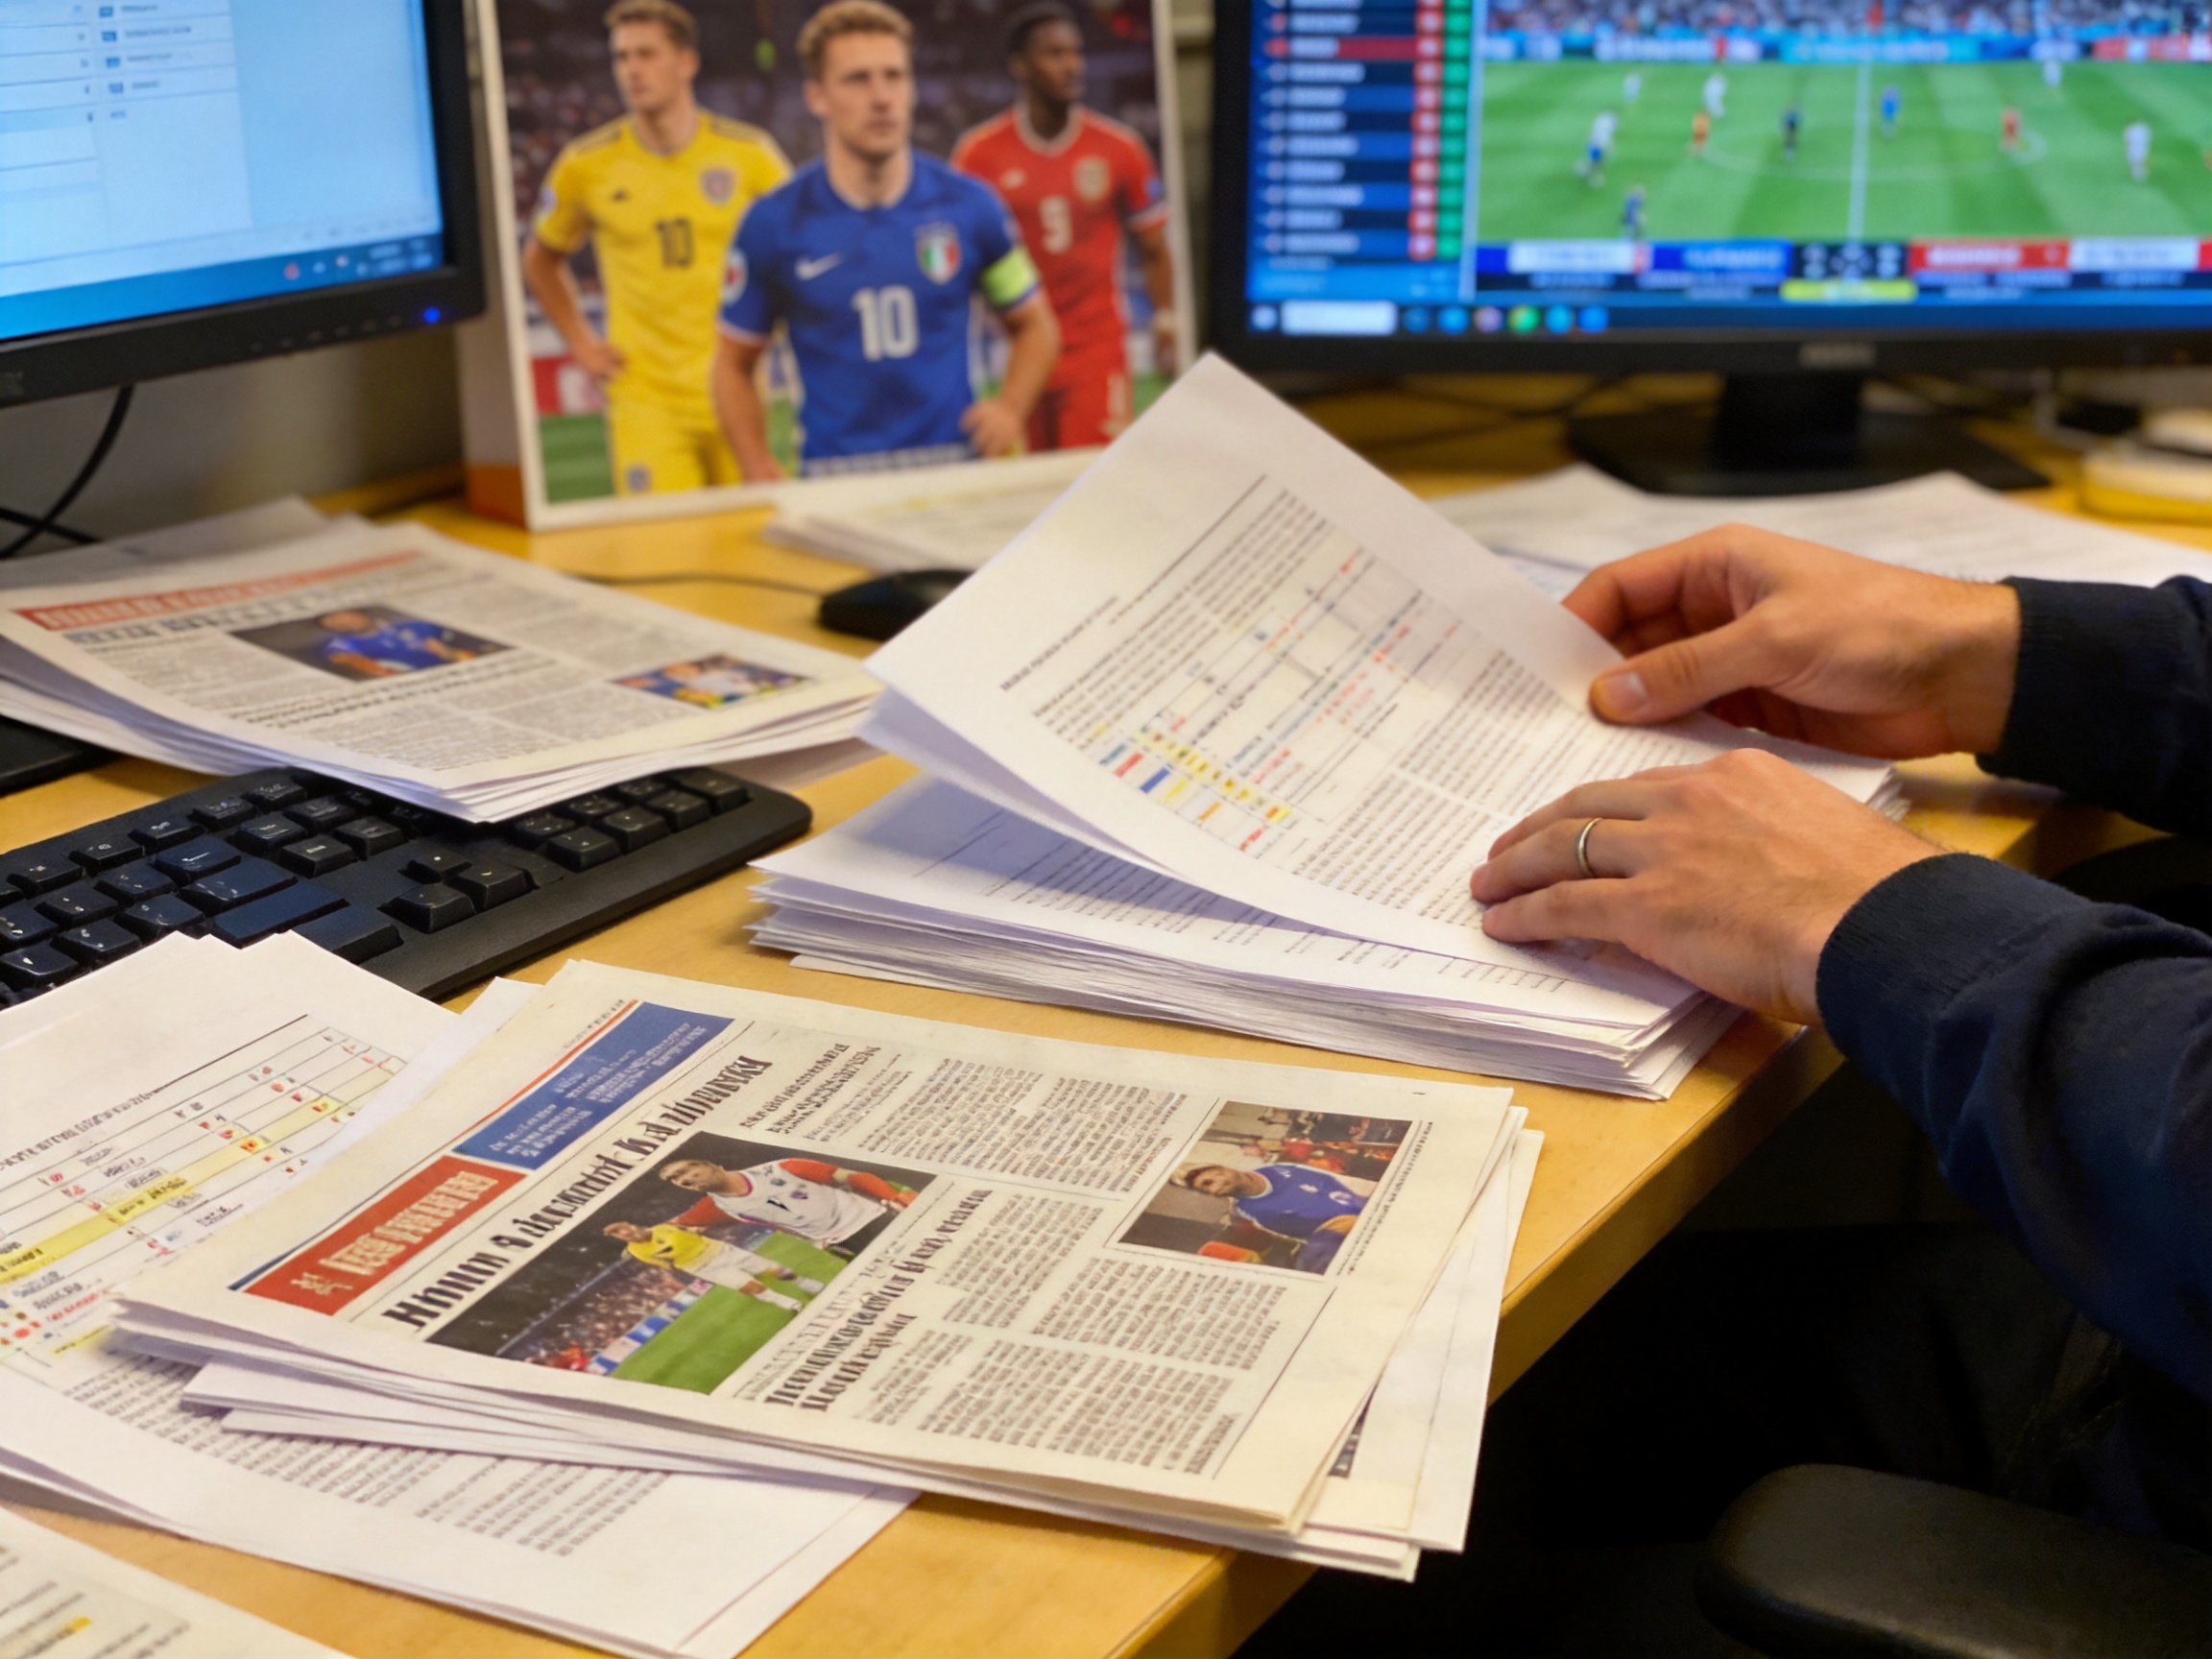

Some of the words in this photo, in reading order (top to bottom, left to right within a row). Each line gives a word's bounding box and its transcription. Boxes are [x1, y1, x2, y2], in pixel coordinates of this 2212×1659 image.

[654, 217, 695, 271] 10
[1040, 197, 1072, 254] 9
[851, 285, 920, 361] 10
